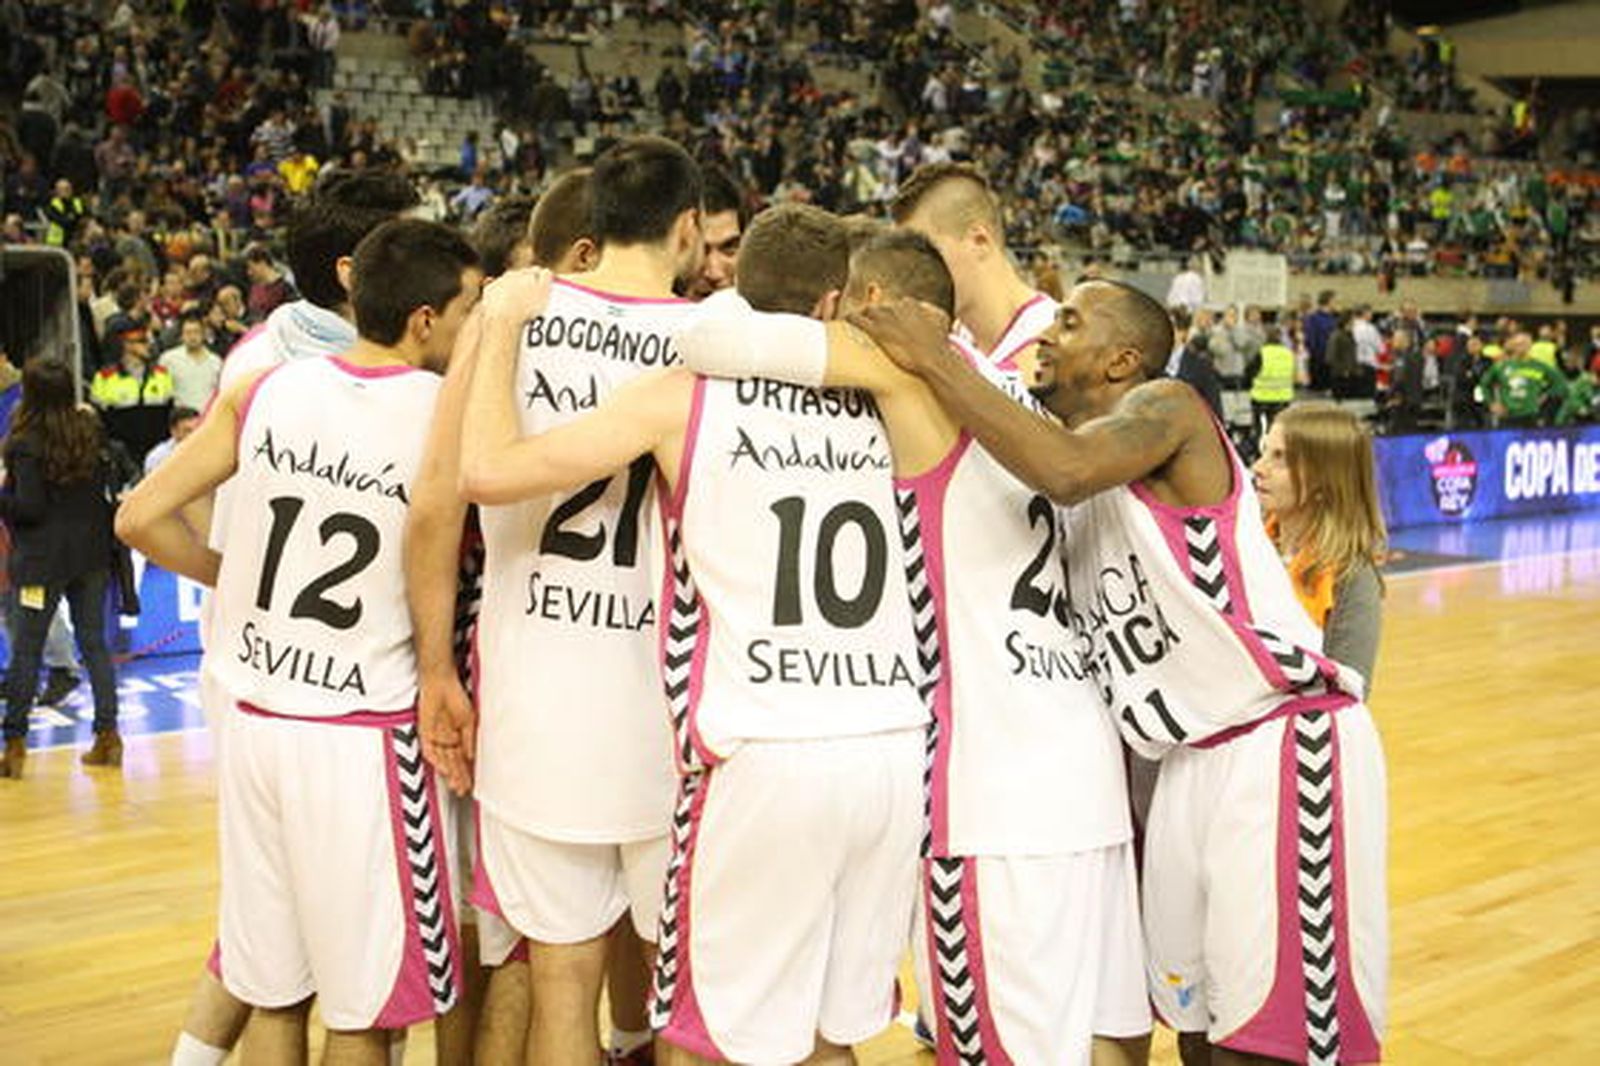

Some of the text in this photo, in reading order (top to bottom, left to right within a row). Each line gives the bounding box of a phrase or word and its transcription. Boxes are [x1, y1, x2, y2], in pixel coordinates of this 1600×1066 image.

[1505, 439, 1570, 500] COPA
[539, 452, 655, 568] 21
[256, 496, 381, 630] 12
[770, 496, 888, 629] 10
[526, 572, 655, 631] SEVILLA
[238, 621, 366, 696] SEVILLA
[747, 639, 916, 688] SEVILLA
